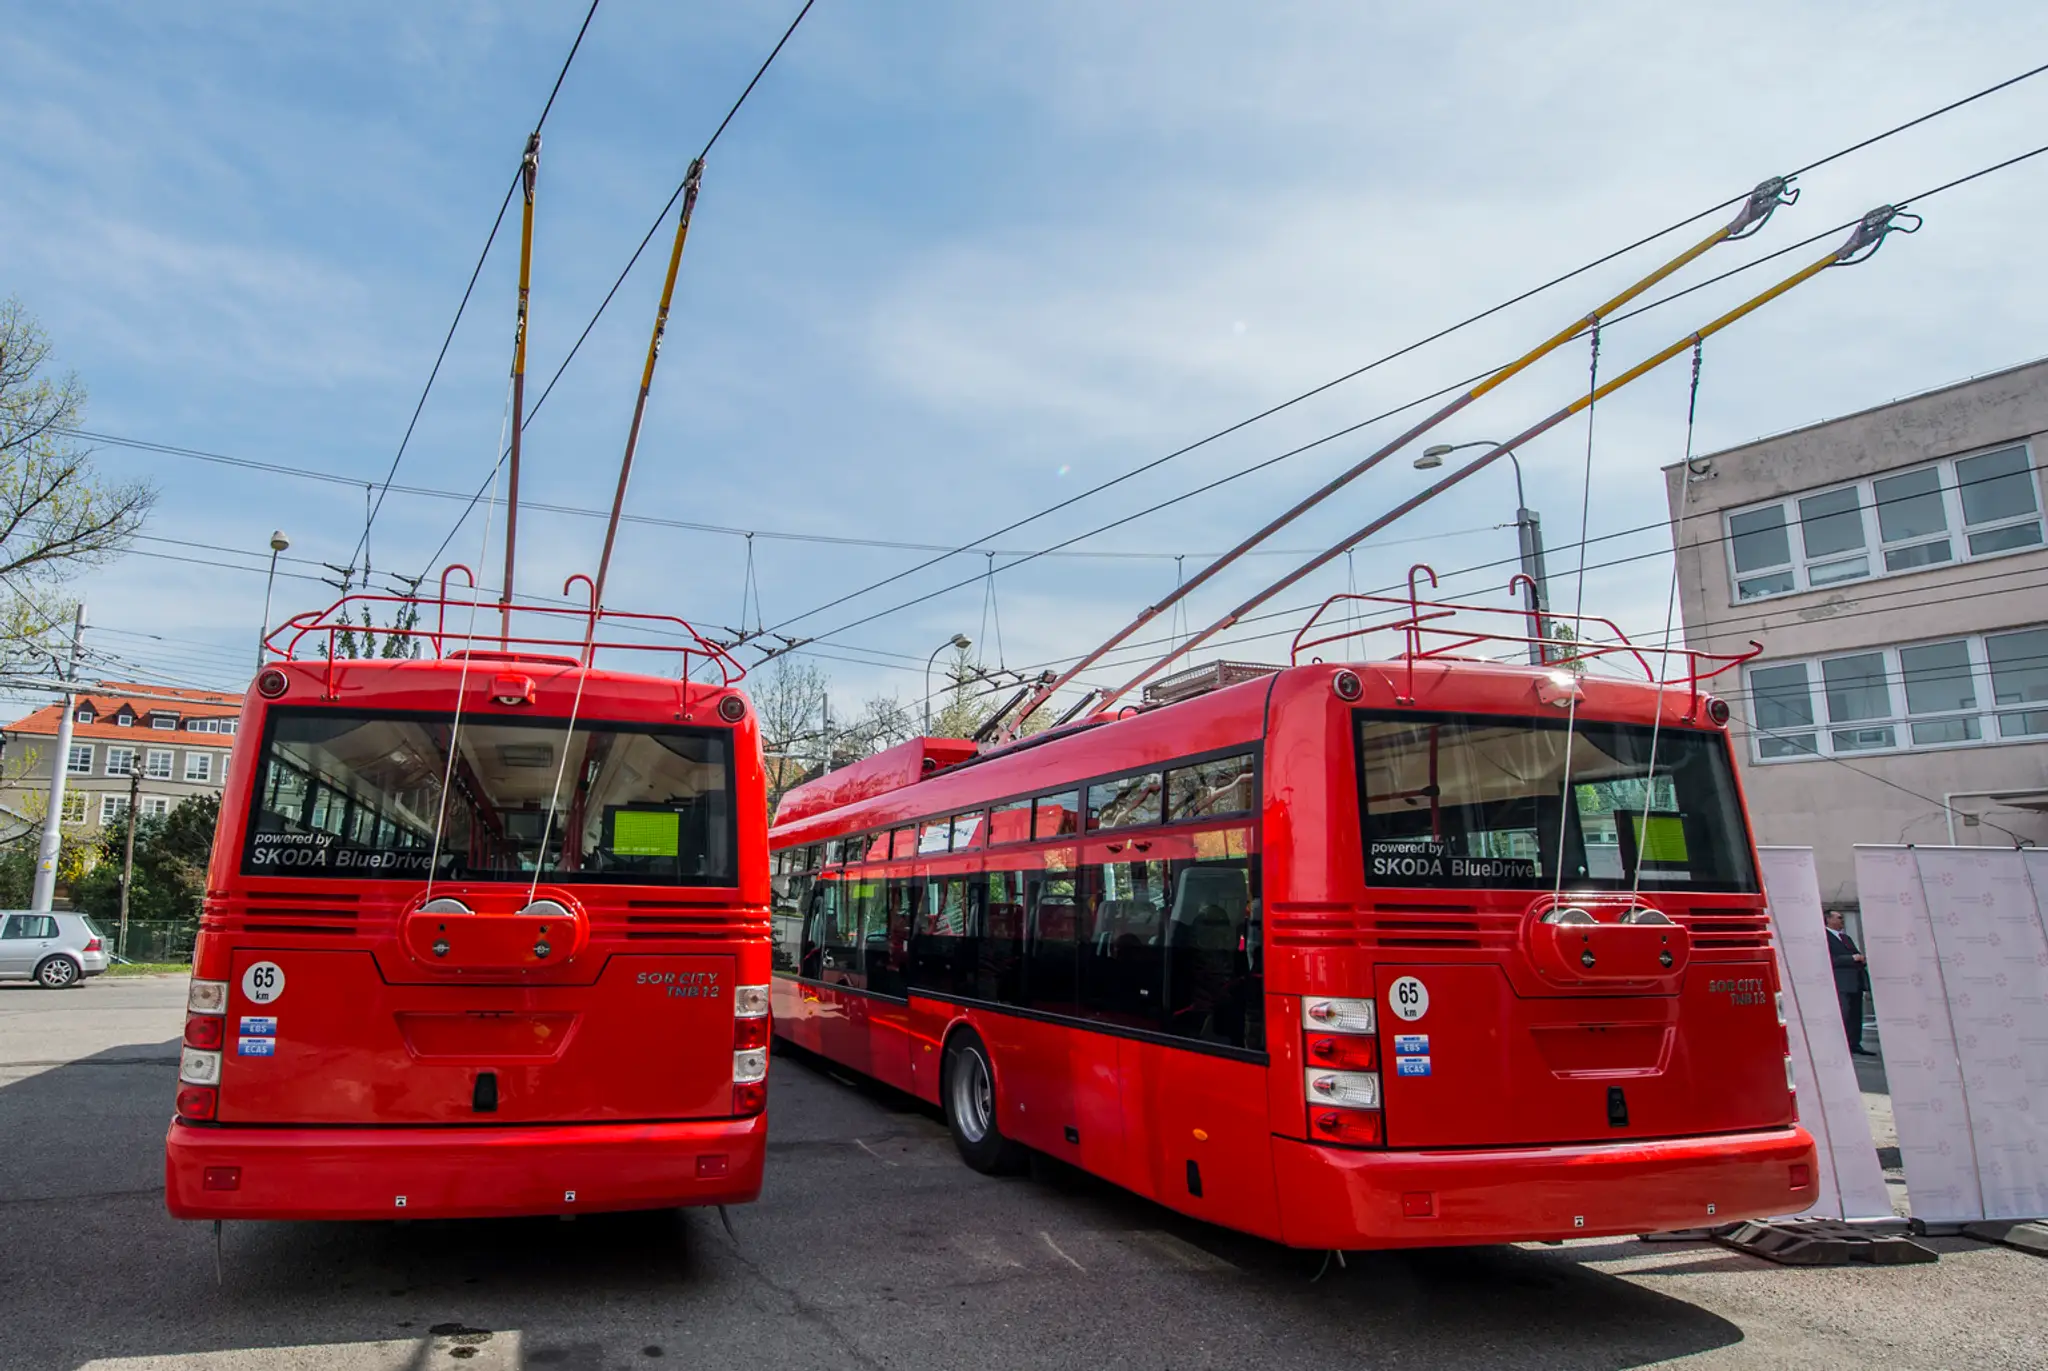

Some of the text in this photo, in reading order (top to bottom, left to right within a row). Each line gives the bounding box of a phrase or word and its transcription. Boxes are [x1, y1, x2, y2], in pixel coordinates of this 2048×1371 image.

[254, 833, 334, 847] powered by
[1371, 842, 1444, 857] powered by
[252, 848, 433, 869] SKODA BlueDrive
[1373, 858, 1535, 878] SKODA BlueDrive
[253, 967, 275, 988] 65
[636, 972, 719, 985] SOR CITY
[1737, 978, 1763, 992] CITY
[255, 990, 269, 1000] km
[1398, 982, 1419, 1004] 65
[1403, 1007, 1417, 1017] km
[244, 1045, 268, 1054] ECAS
[1403, 1064, 1425, 1074] ECAS
